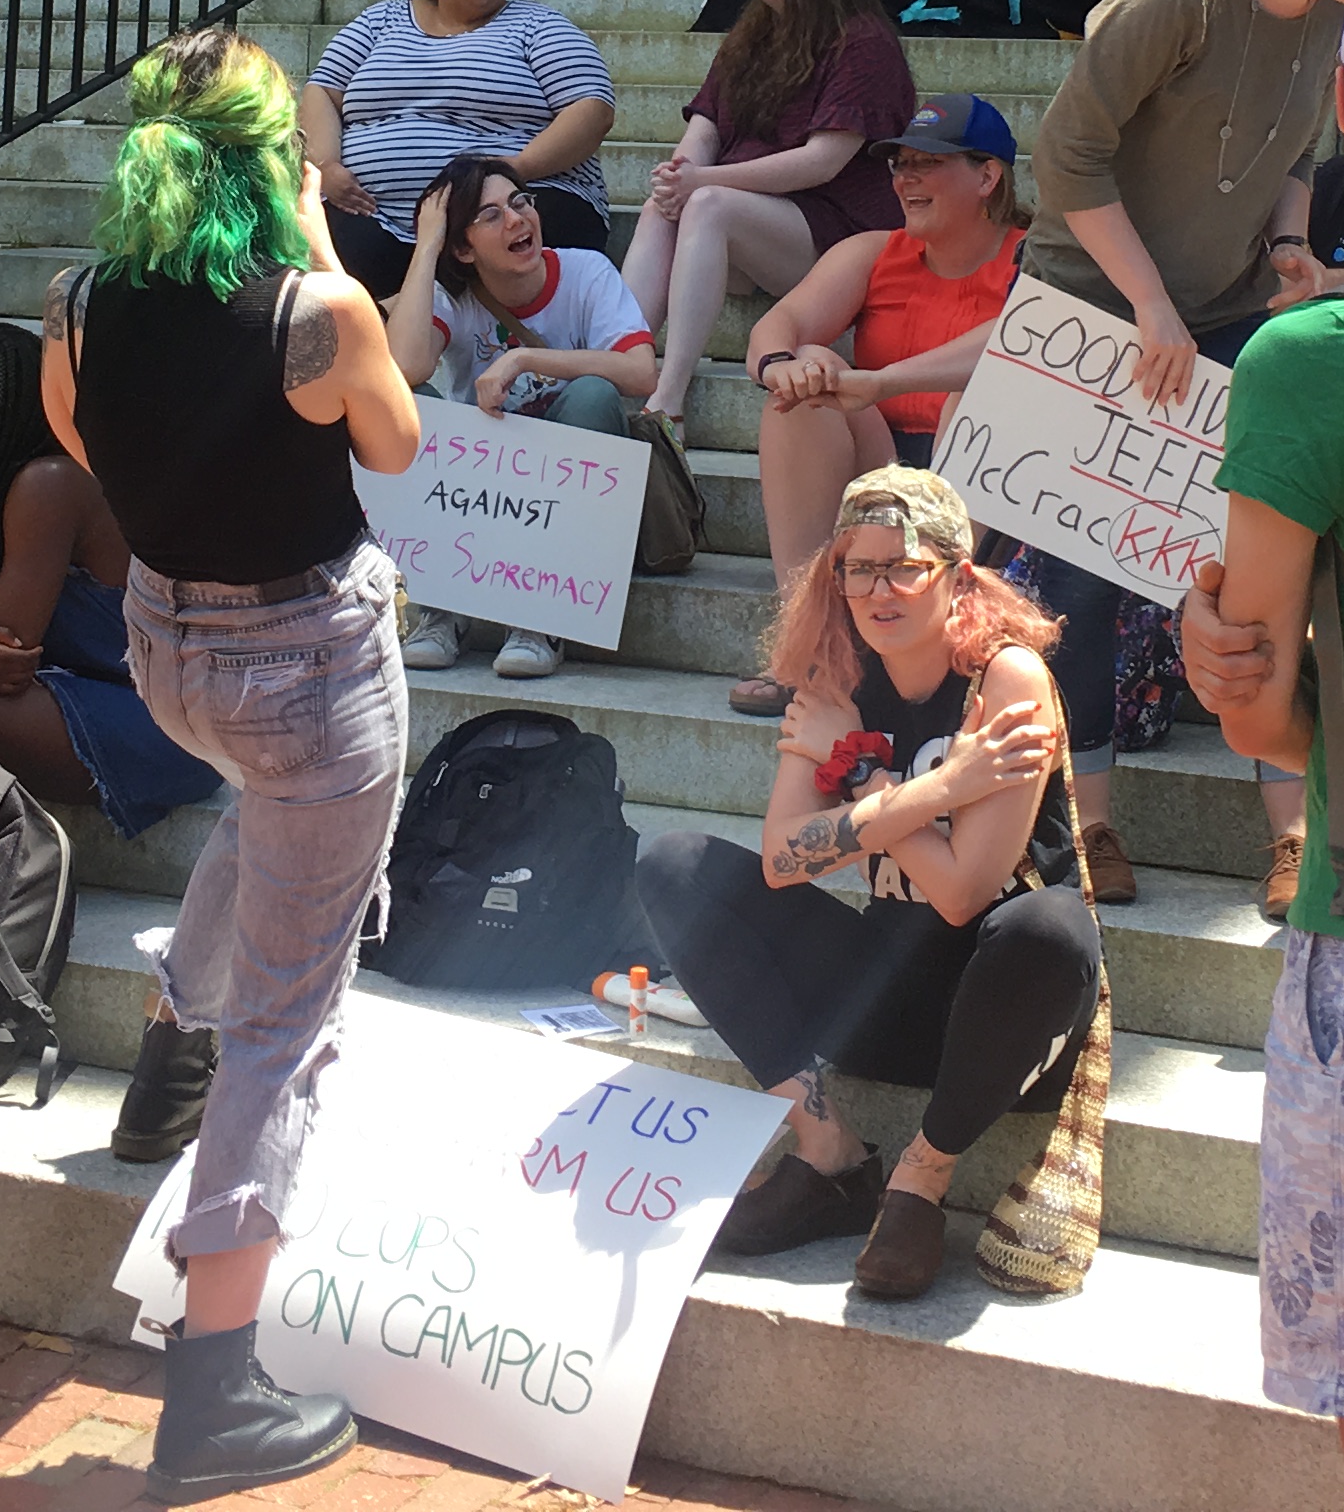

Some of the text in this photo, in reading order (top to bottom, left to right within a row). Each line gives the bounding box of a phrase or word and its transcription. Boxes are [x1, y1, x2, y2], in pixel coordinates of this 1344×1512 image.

[999, 295, 1144, 398] GOOD
[1073, 403, 1224, 513] JEFF
[423, 479, 561, 530] AGAINST
[631, 1096, 710, 1145] US
[605, 1166, 683, 1223] US
[280, 1268, 594, 1416] ON CAMPUS
